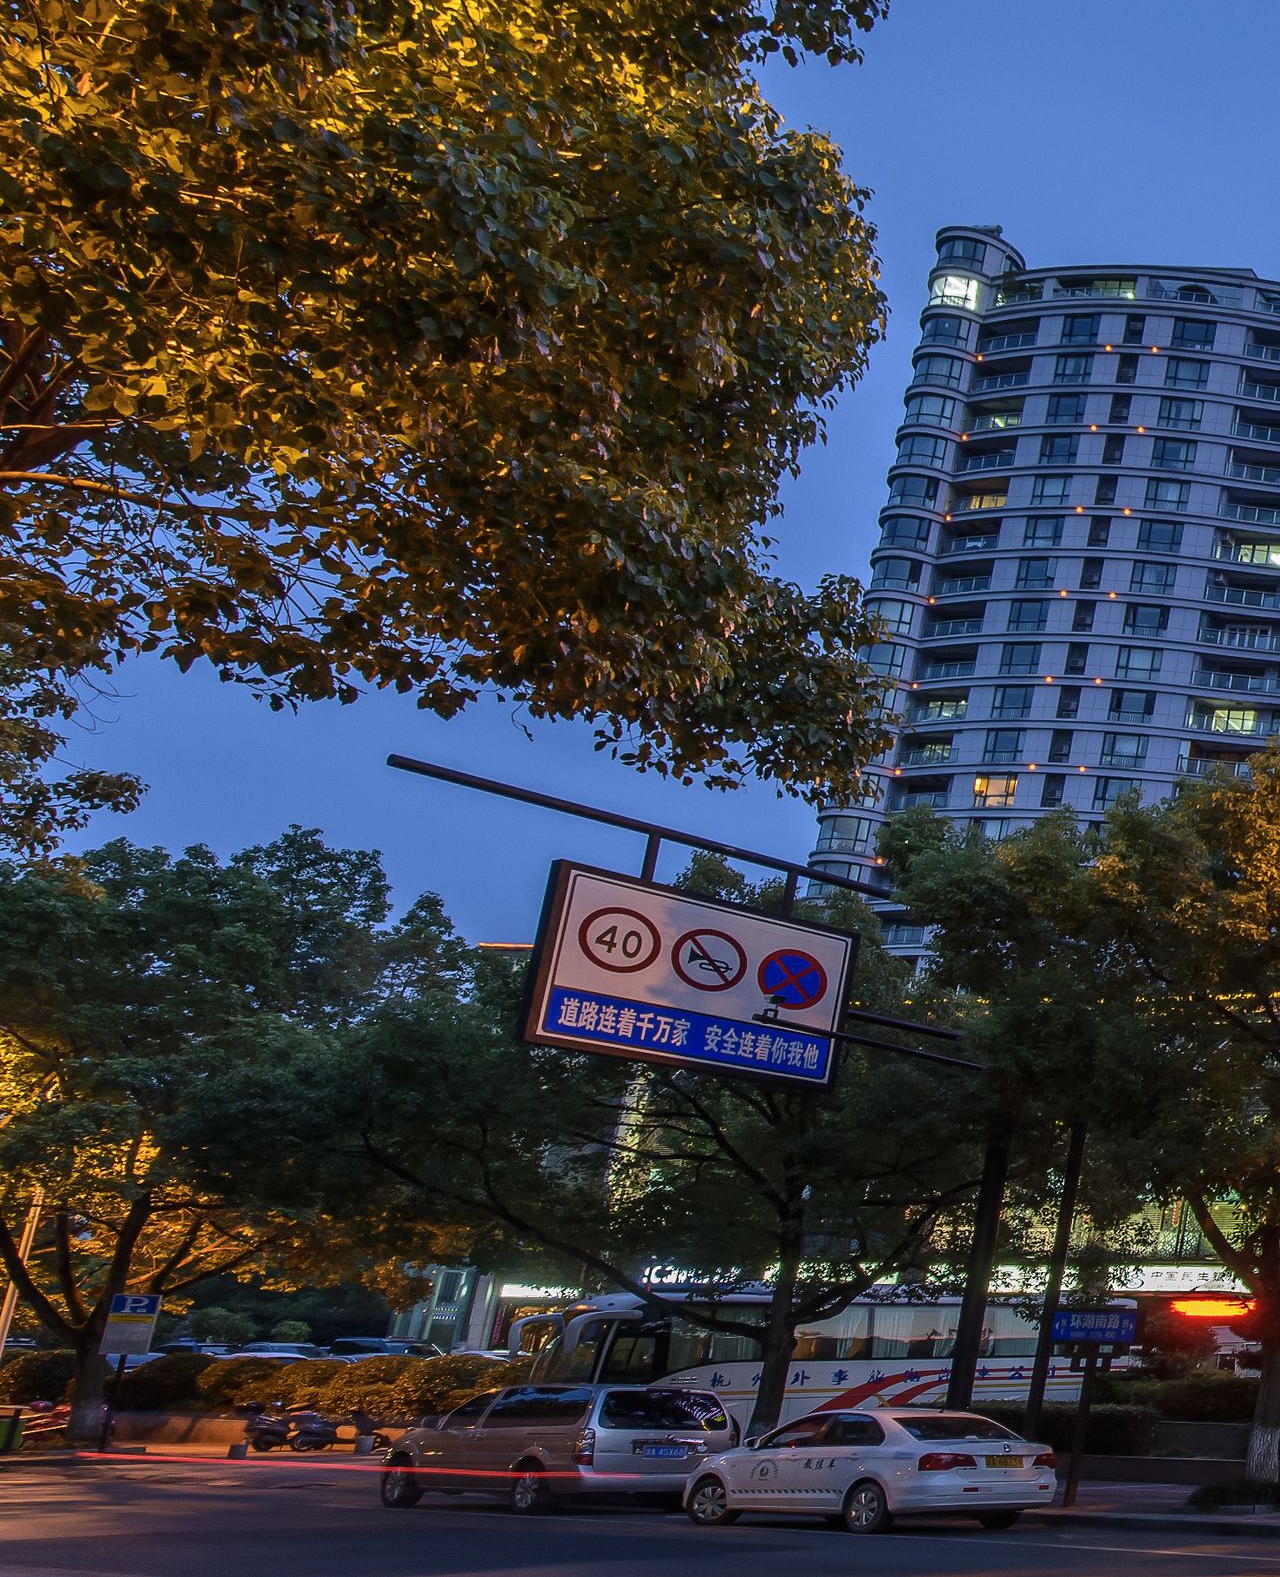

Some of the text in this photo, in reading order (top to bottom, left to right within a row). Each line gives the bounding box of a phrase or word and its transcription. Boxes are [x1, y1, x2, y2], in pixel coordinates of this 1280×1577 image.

[595, 925, 643, 959] 40
[557, 997, 820, 1071] 道路连着千万家 安全连着你我他
[1150, 1270, 1236, 1283] 中国民生银
[1069, 1313, 1121, 1330] 环湖南路
[802, 1457, 836, 1471] 教练车
